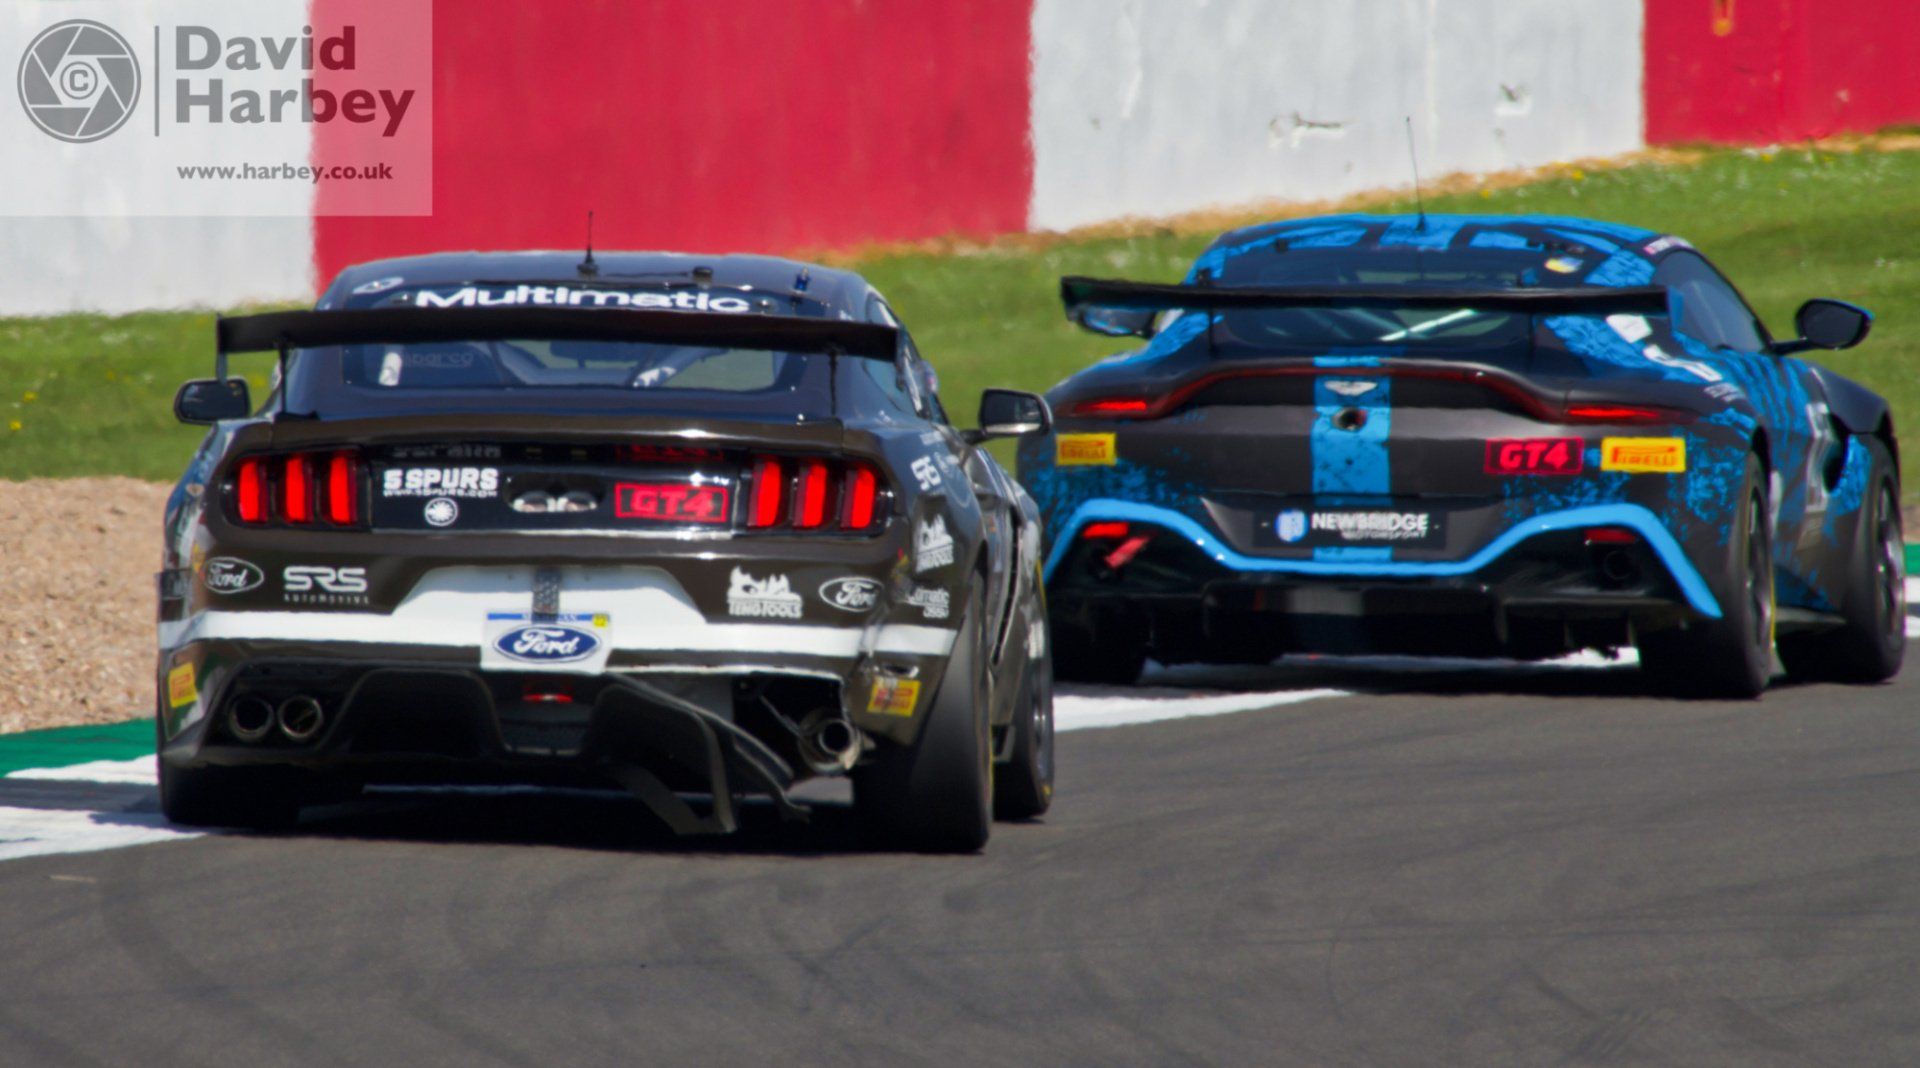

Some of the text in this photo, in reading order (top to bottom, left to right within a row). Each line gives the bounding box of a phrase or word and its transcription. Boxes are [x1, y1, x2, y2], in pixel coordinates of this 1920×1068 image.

[415, 285, 750, 314] Multimatic
[1500, 441, 1569, 470] GT4
[383, 467, 498, 491] 5 SPURS
[630, 488, 714, 517] GT4
[1311, 511, 1429, 531] NEWBRIDGE
[208, 562, 248, 588] Ford
[283, 566, 368, 592] SRS
[513, 627, 581, 654] Ford
